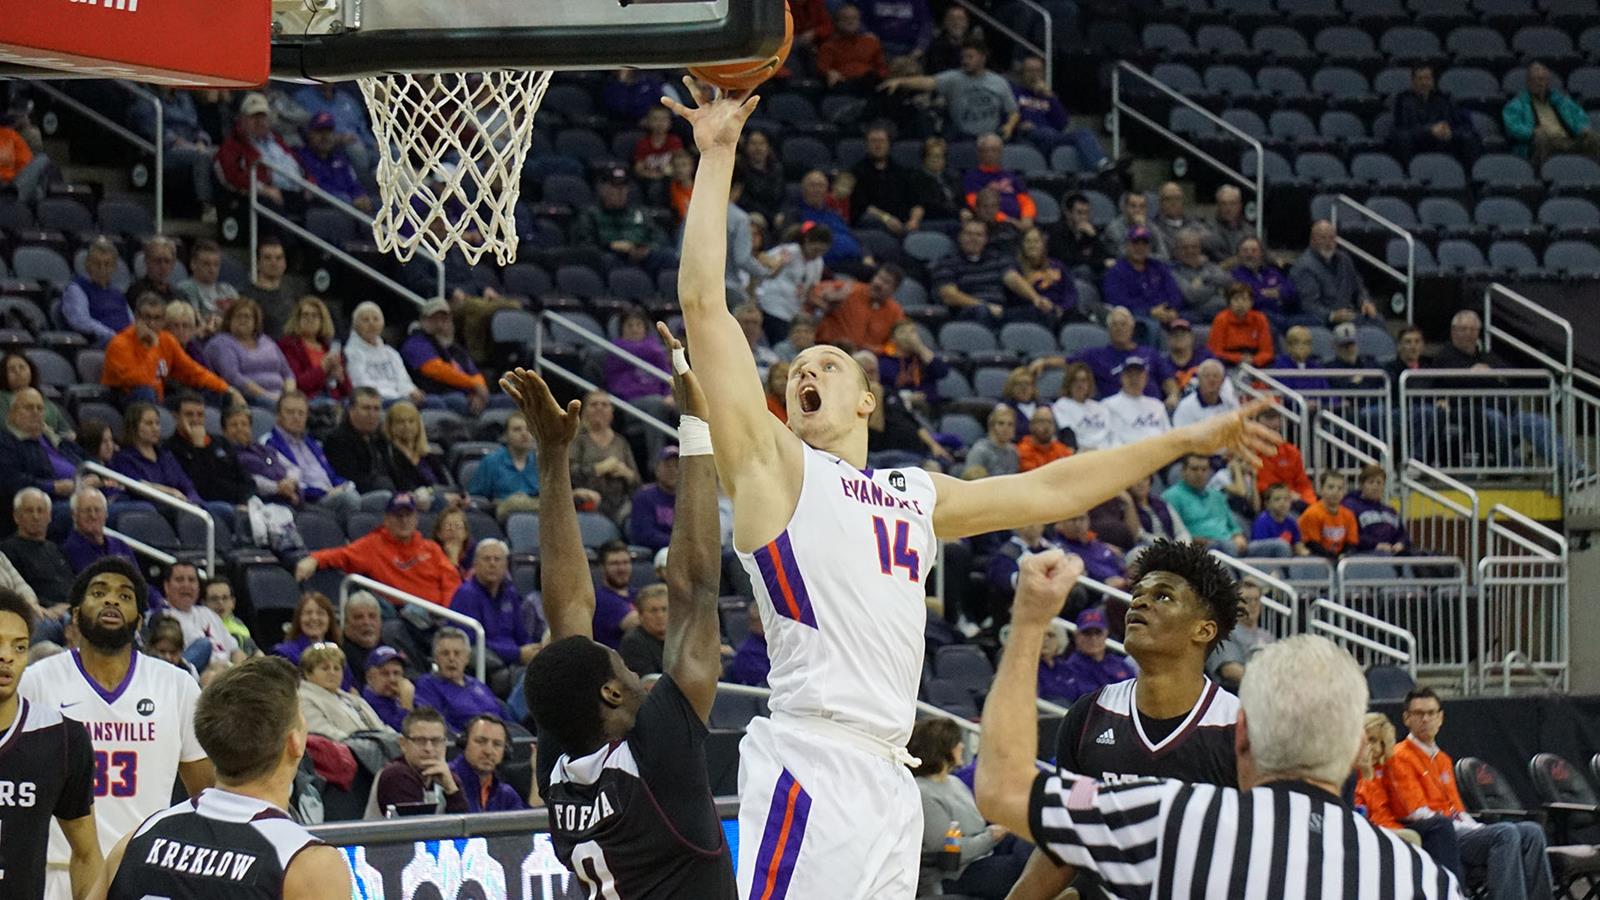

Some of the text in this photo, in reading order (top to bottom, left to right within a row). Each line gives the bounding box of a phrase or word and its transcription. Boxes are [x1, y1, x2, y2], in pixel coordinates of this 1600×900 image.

[872, 514, 919, 583] 14
[83, 721, 156, 742] ANSVILLE
[142, 838, 257, 881] KREKLOW
[571, 839, 622, 900] 0
